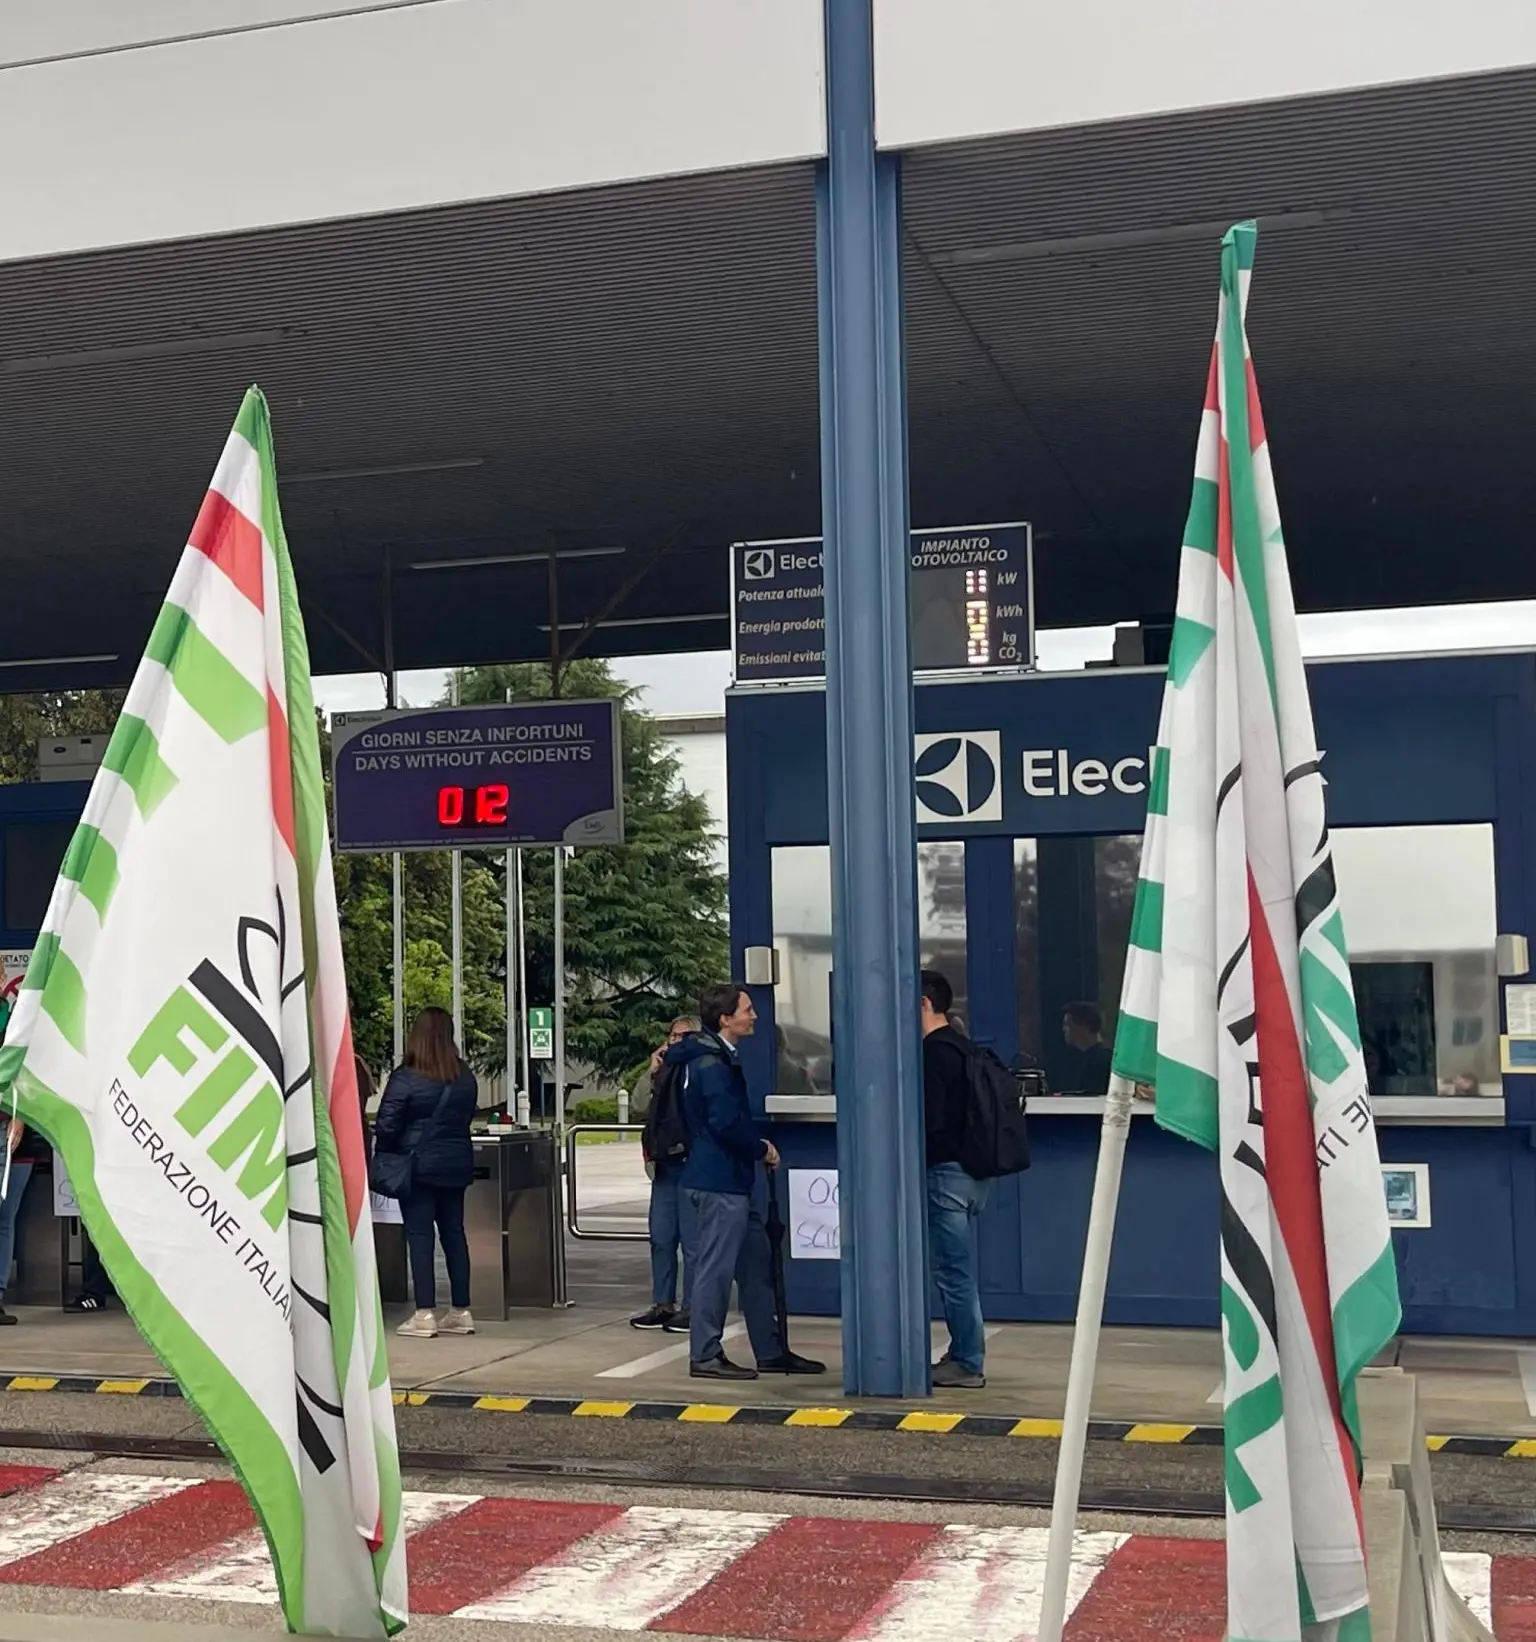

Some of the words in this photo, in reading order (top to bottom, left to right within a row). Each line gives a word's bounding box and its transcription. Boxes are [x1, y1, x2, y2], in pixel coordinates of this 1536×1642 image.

[920, 537, 990, 553] IMPIANTO
[780, 553, 824, 570] Elect
[912, 549, 1008, 567] OTOVOLTAICO
[997, 572, 1017, 585] kW
[738, 590, 784, 602] Potenza
[996, 605, 1023, 618] kWh
[739, 619, 781, 635] Energia
[782, 617, 825, 635] prodott
[1002, 631, 1017, 645] kg
[739, 651, 791, 666] Emissioni
[792, 650, 826, 663] evitat
[361, 730, 421, 748] GIORNI
[425, 728, 483, 744] SENZA
[488, 723, 584, 742] INFORTUNI
[355, 753, 401, 771] DAYS
[404, 751, 485, 768] WITHOUT
[491, 746, 592, 765] ACCIDENTS
[1022, 746, 1156, 797] Elec
[535, 1010, 544, 1026] 1
[128, 986, 289, 1233] FIM
[109, 1078, 241, 1244] FEDERAZIONE
